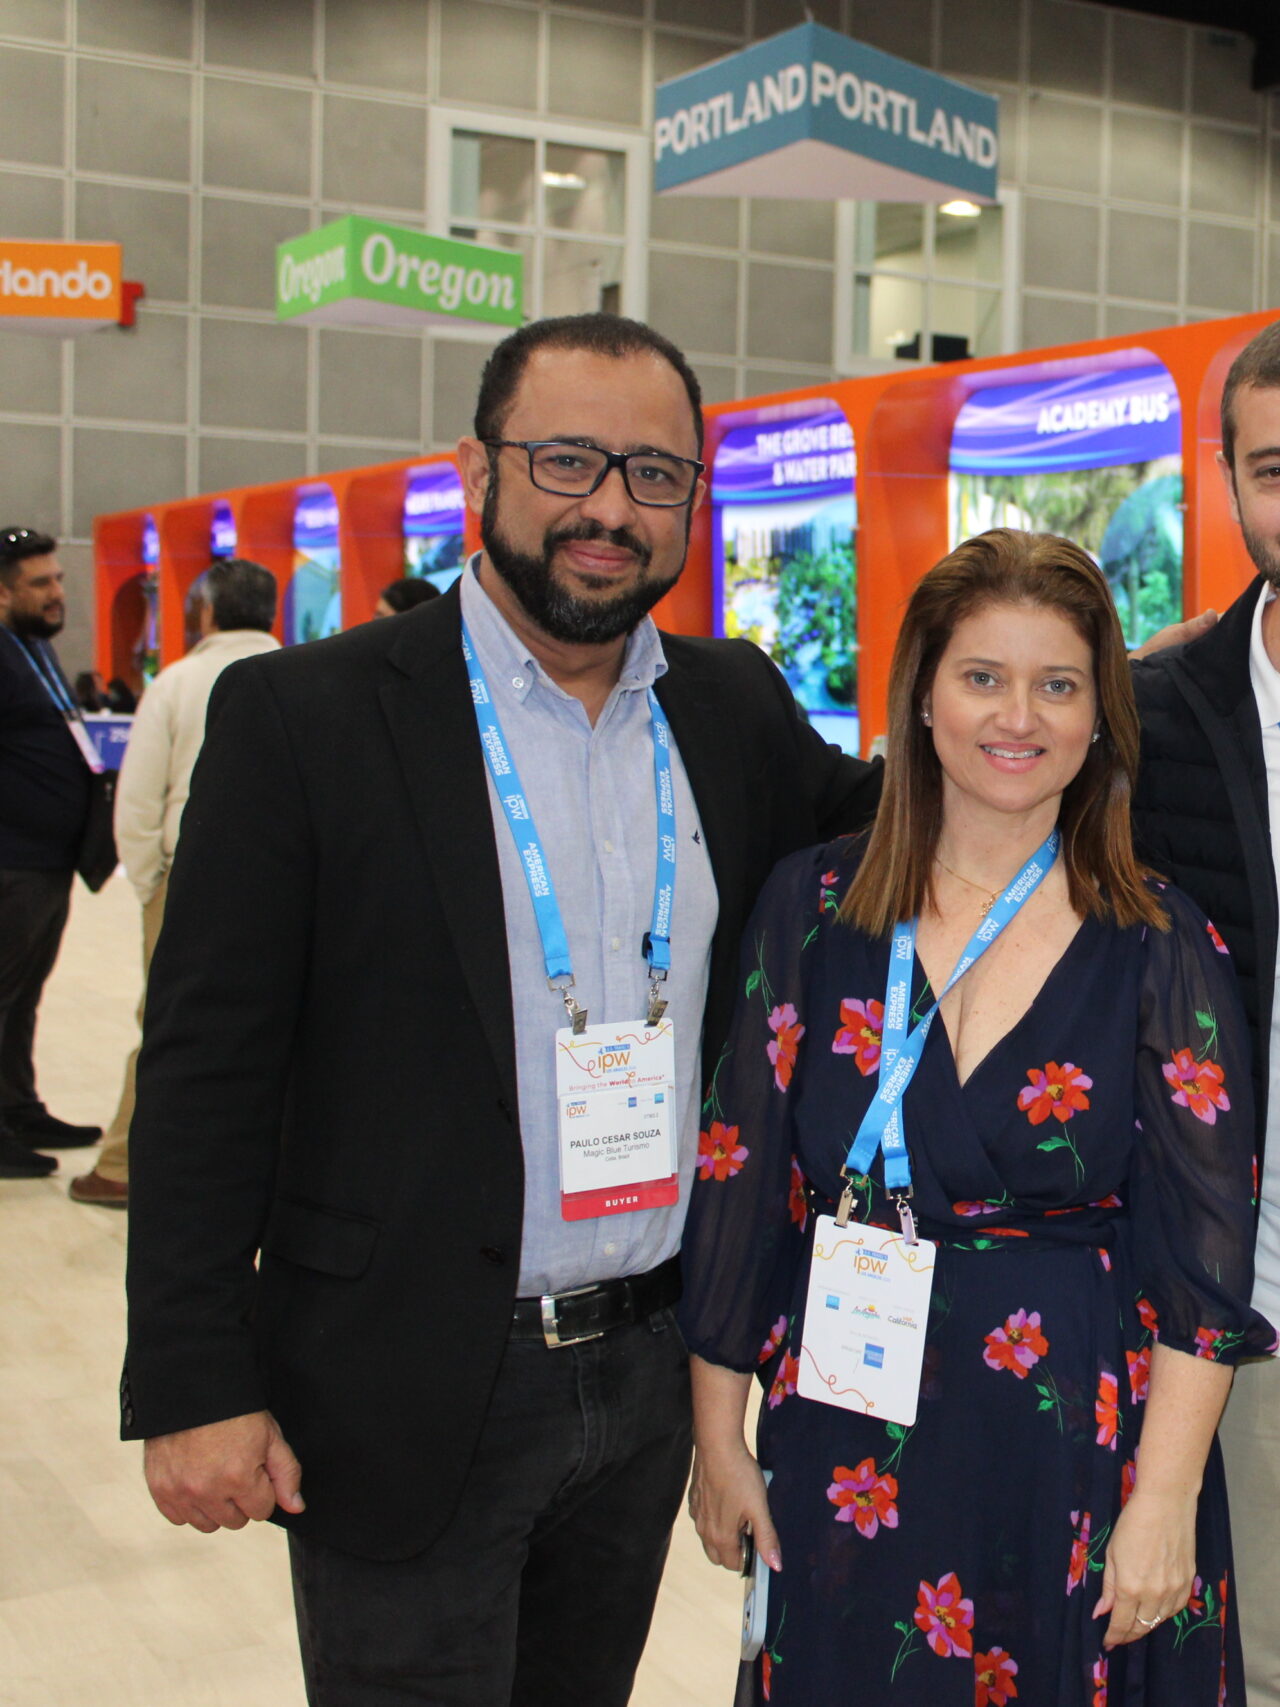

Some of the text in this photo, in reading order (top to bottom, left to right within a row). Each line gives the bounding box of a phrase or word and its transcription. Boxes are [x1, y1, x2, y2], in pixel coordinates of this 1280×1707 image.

[654, 64, 807, 161] PORTLAND
[812, 61, 997, 168] PORTLAND
[0, 259, 112, 299] lando
[280, 245, 345, 303] Oregon
[362, 233, 515, 310] Oregon
[1036, 391, 1170, 435] ACADEMY BUS
[756, 431, 782, 457] THE
[782, 425, 829, 455] GROVE
[773, 461, 785, 486] &
[784, 455, 829, 484] WATER
[481, 732, 504, 776] EXPRESS
[487, 725, 512, 775] AMERICAN
[504, 794, 526, 820] ipw
[660, 770, 669, 815] EXPRESS
[662, 766, 673, 817] AMERICAN
[527, 842, 550, 896] AMERICAN
[662, 835, 674, 863] ipw
[522, 850, 542, 898] EXPRESS
[1004, 862, 1039, 904] AMERICAN
[1013, 867, 1044, 903] EXPRESS
[655, 888, 667, 938] EXPRESS
[660, 884, 672, 938] AMERICAN
[979, 920, 1000, 942] ipw
[895, 936, 907, 960] ipw
[887, 986, 899, 1030] EXPRESS
[895, 981, 907, 1030] AMERICAN
[598, 1051, 630, 1073] ipw
[879, 1056, 905, 1104] EXPRESS
[883, 1048, 899, 1071] ip
[885, 1055, 915, 1104] AMERICAN
[569, 1083, 596, 1091] Bringing
[566, 1106, 587, 1118] ipw
[890, 1107, 901, 1148] ERICAN
[570, 1129, 661, 1149] PAULO CESAR SOUZA
[583, 1142, 650, 1158] Magic Blue Turismo
[605, 1195, 639, 1207] BUYER
[854, 1255, 888, 1274] ipw
[888, 1315, 918, 1330] California
